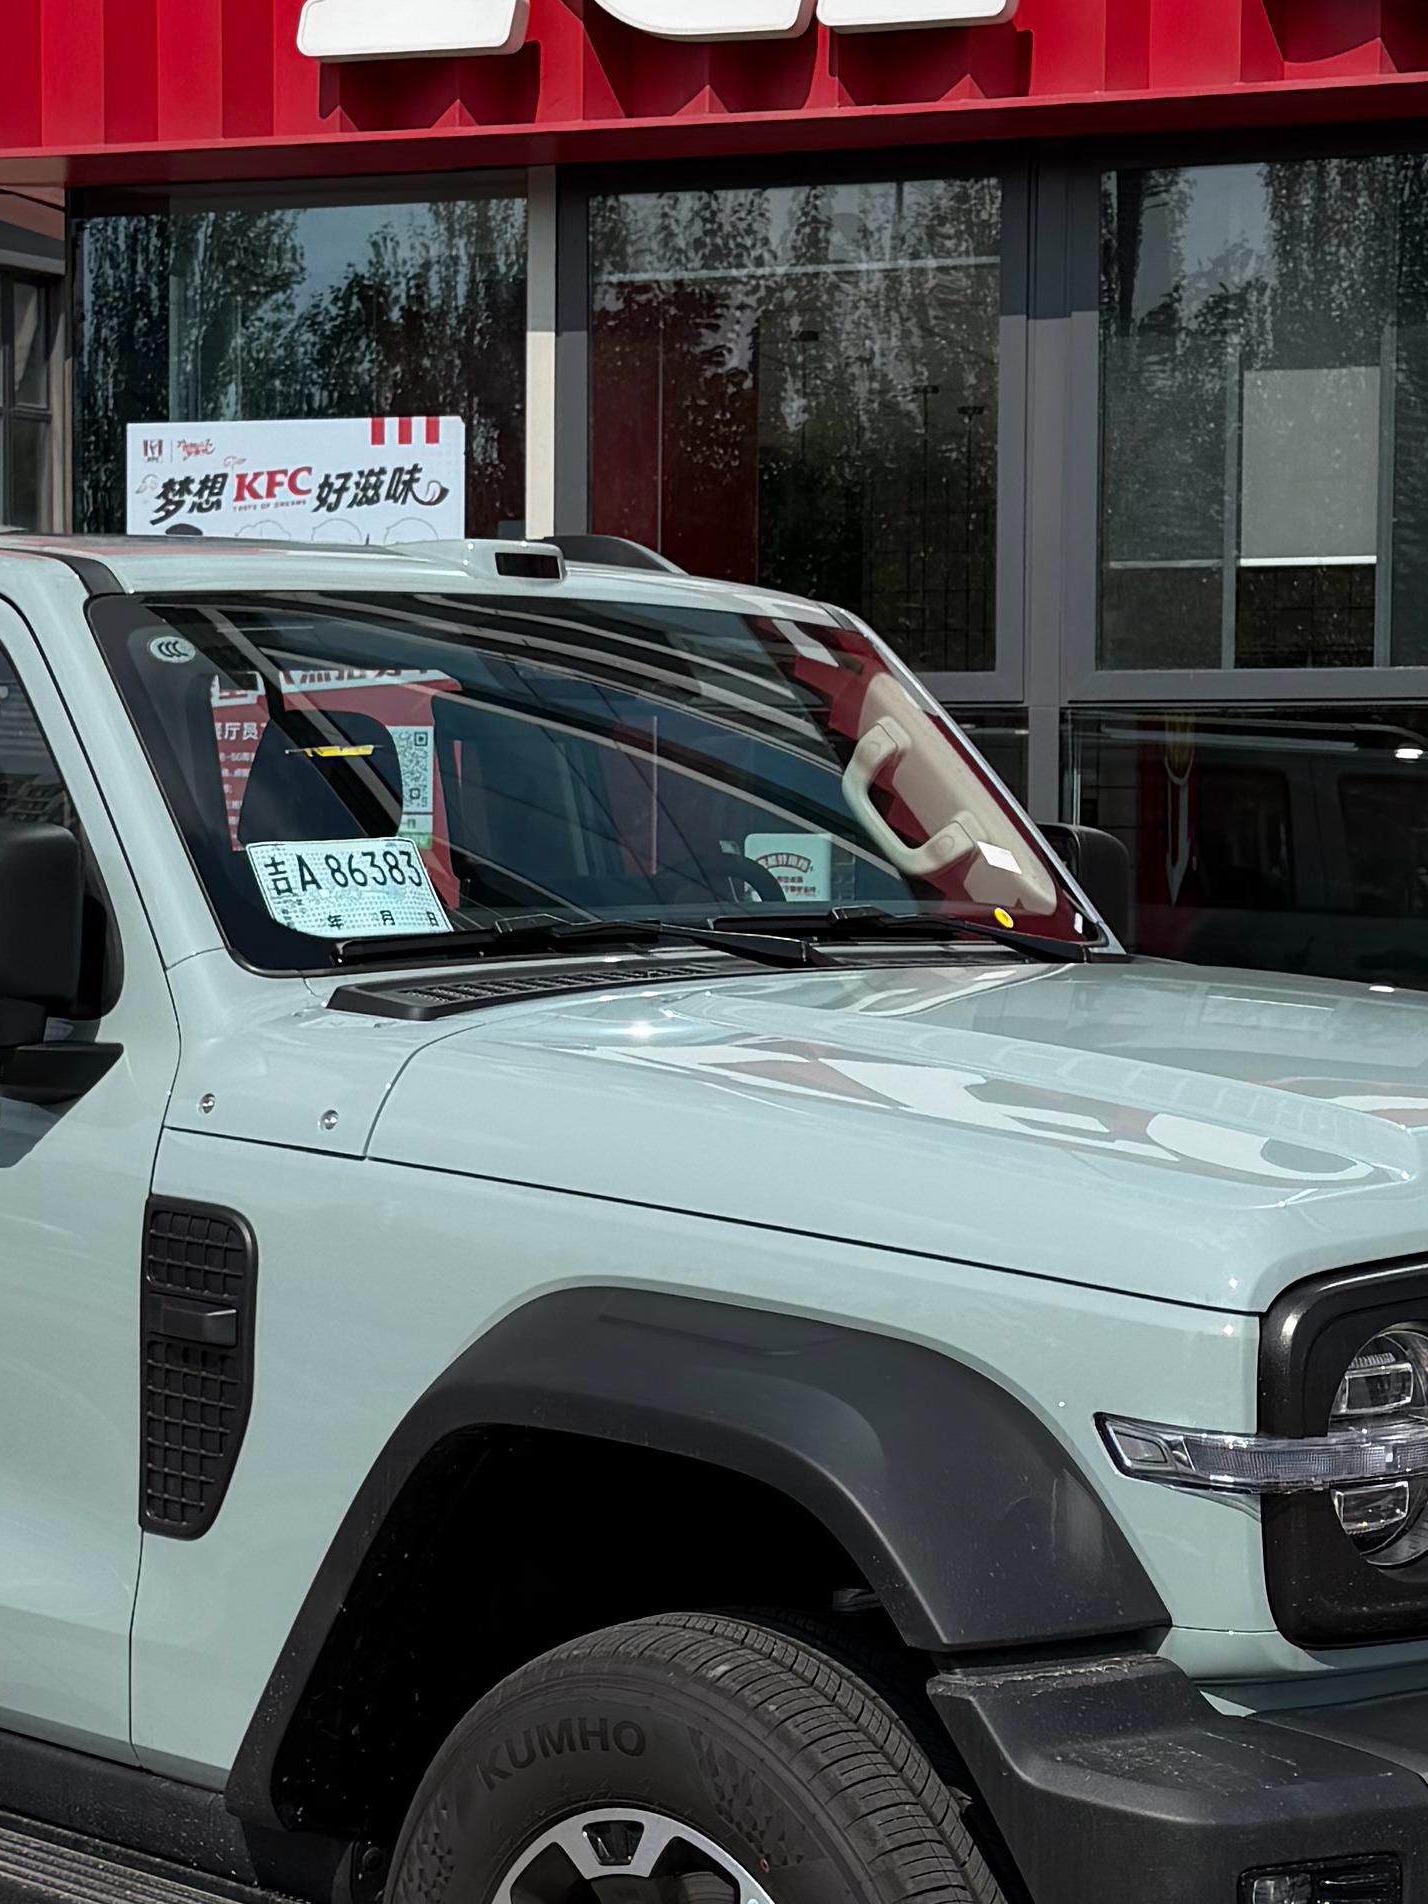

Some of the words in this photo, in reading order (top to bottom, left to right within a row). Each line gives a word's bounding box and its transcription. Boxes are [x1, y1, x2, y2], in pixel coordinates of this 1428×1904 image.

[150, 472, 228, 525] 梦想
[233, 466, 312, 502] KFC
[312, 463, 449, 513] 好滋味
[327, 913, 344, 929] 年
[380, 910, 394, 926] 月
[428, 911, 439, 927] 日
[476, 1717, 646, 1792] KUMHO
